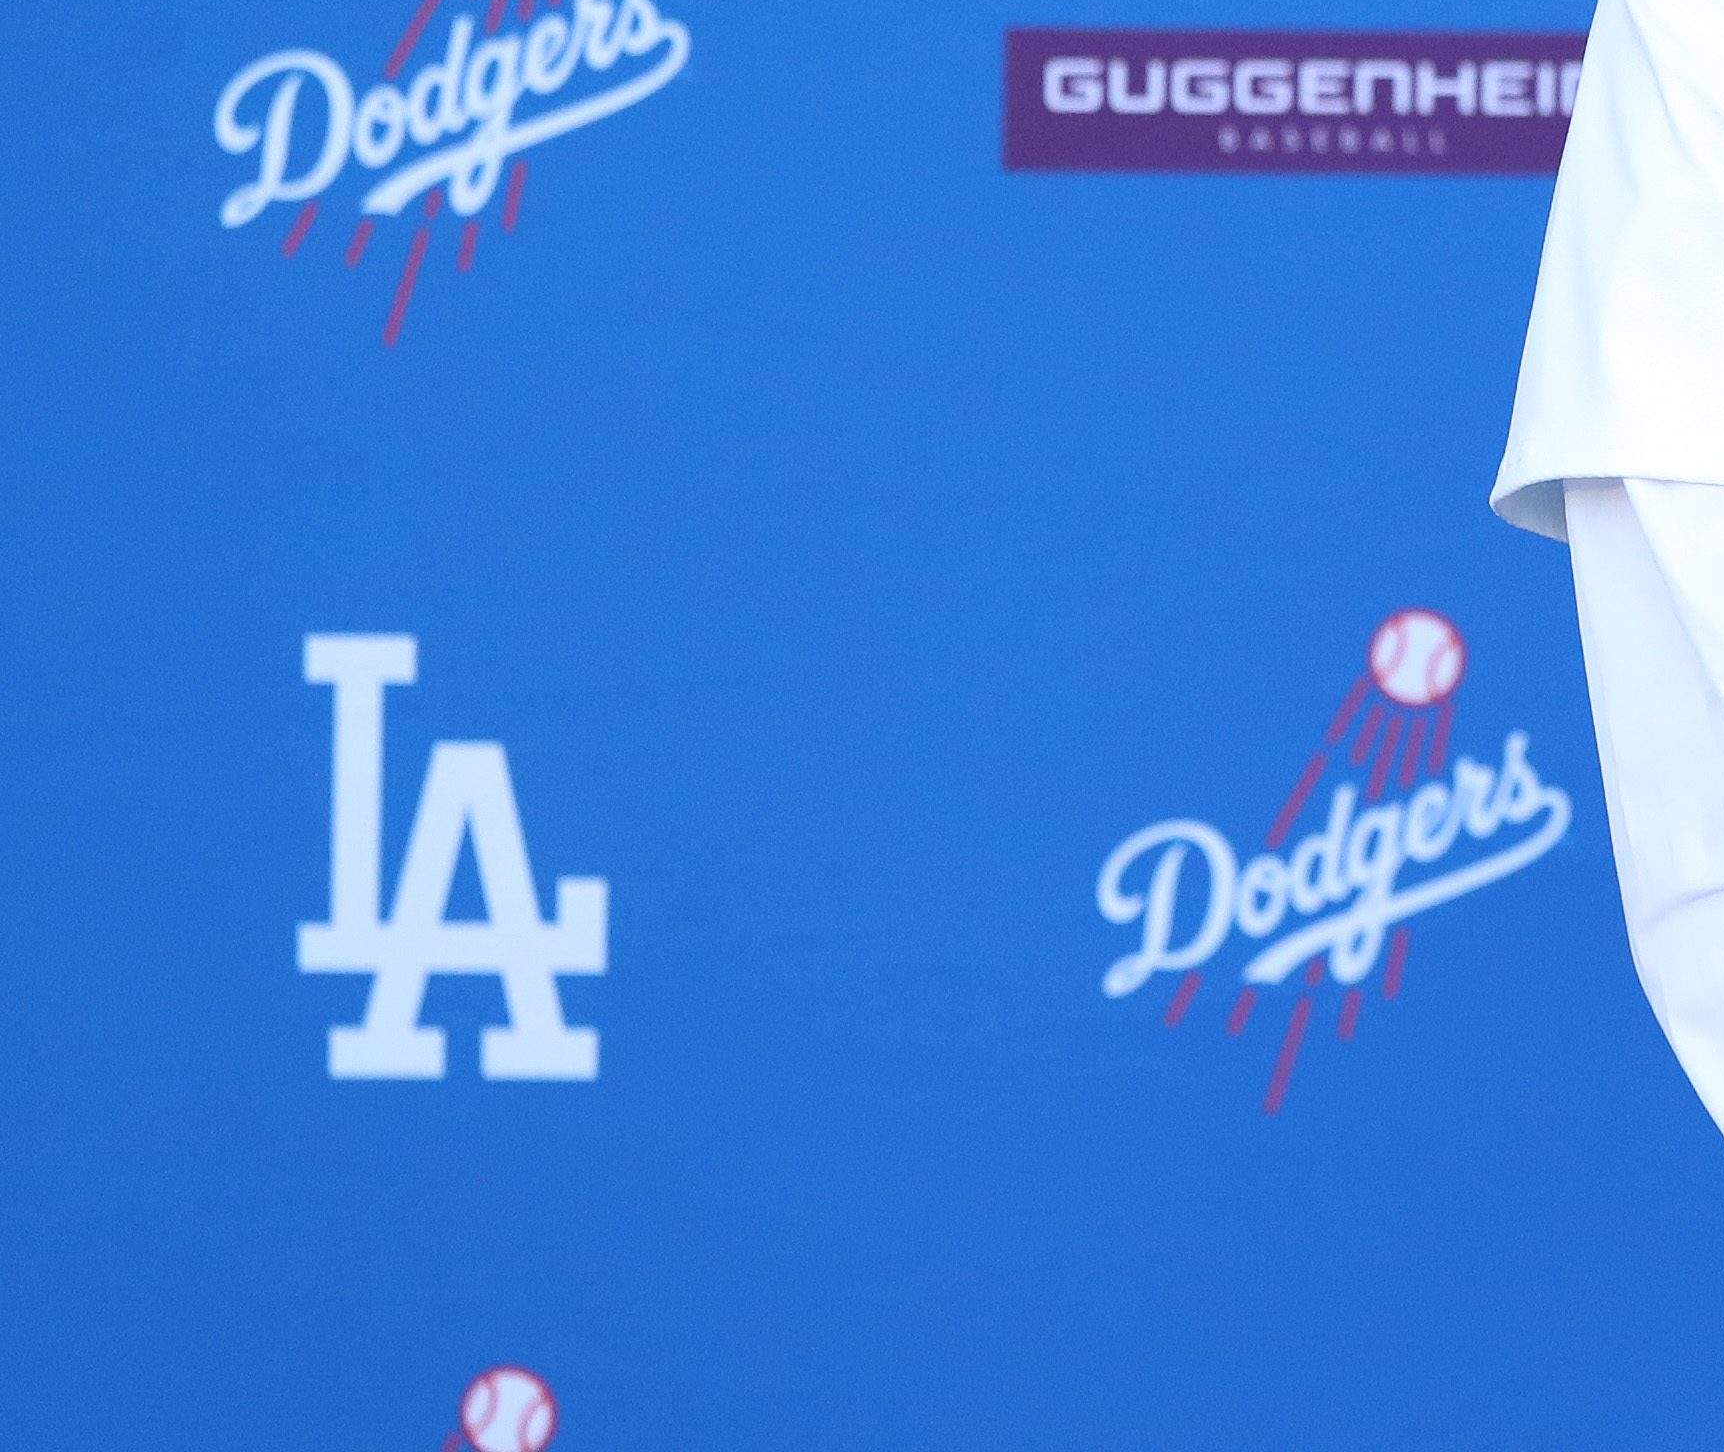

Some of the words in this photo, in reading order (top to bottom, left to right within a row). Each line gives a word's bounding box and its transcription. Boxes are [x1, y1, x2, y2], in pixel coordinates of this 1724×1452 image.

[1042, 56, 1584, 118] GUGGENHEI
[296, 633, 609, 1081] LA
[1096, 731, 1571, 999] Dodgers
